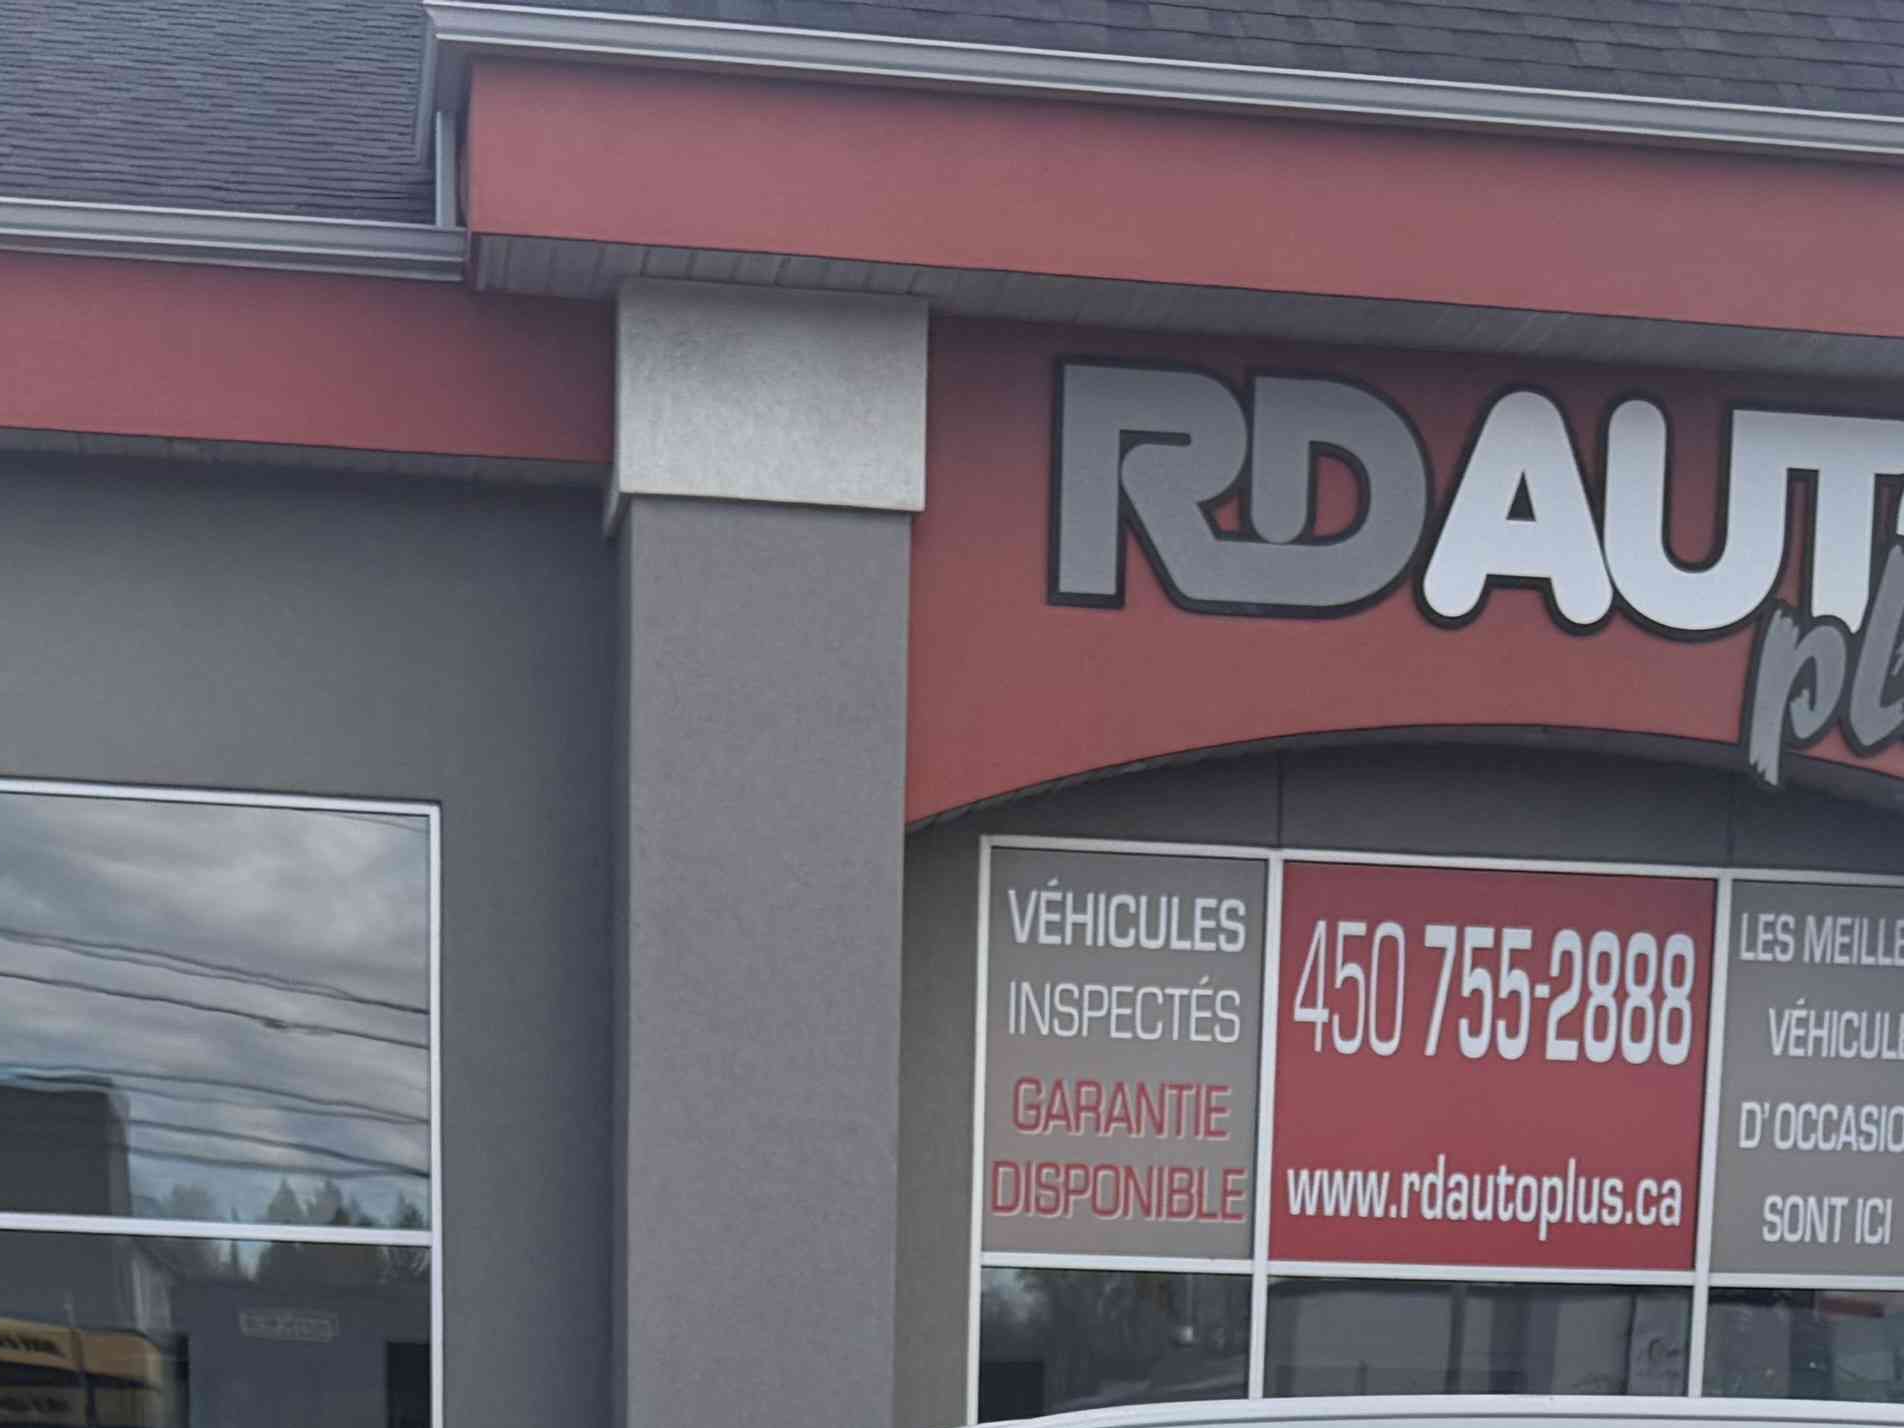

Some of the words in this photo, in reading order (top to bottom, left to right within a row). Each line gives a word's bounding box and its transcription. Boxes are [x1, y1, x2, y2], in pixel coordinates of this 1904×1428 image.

[1008, 877, 1247, 954] VÉHICULES
[1739, 911, 1796, 963] LES
[1007, 977, 1242, 1045] INSPECTÉS
[1293, 918, 1404, 1058] 450
[1423, 923, 1698, 1066] 755-2888
[1012, 1076, 1231, 1141] GARANTIE
[991, 1158, 1248, 1225] DISPONIBLE
[1286, 1153, 1684, 1243] www.rdautoplus.ca
[1762, 1193, 1850, 1244] SONT
[1854, 1198, 1892, 1246] ICI
